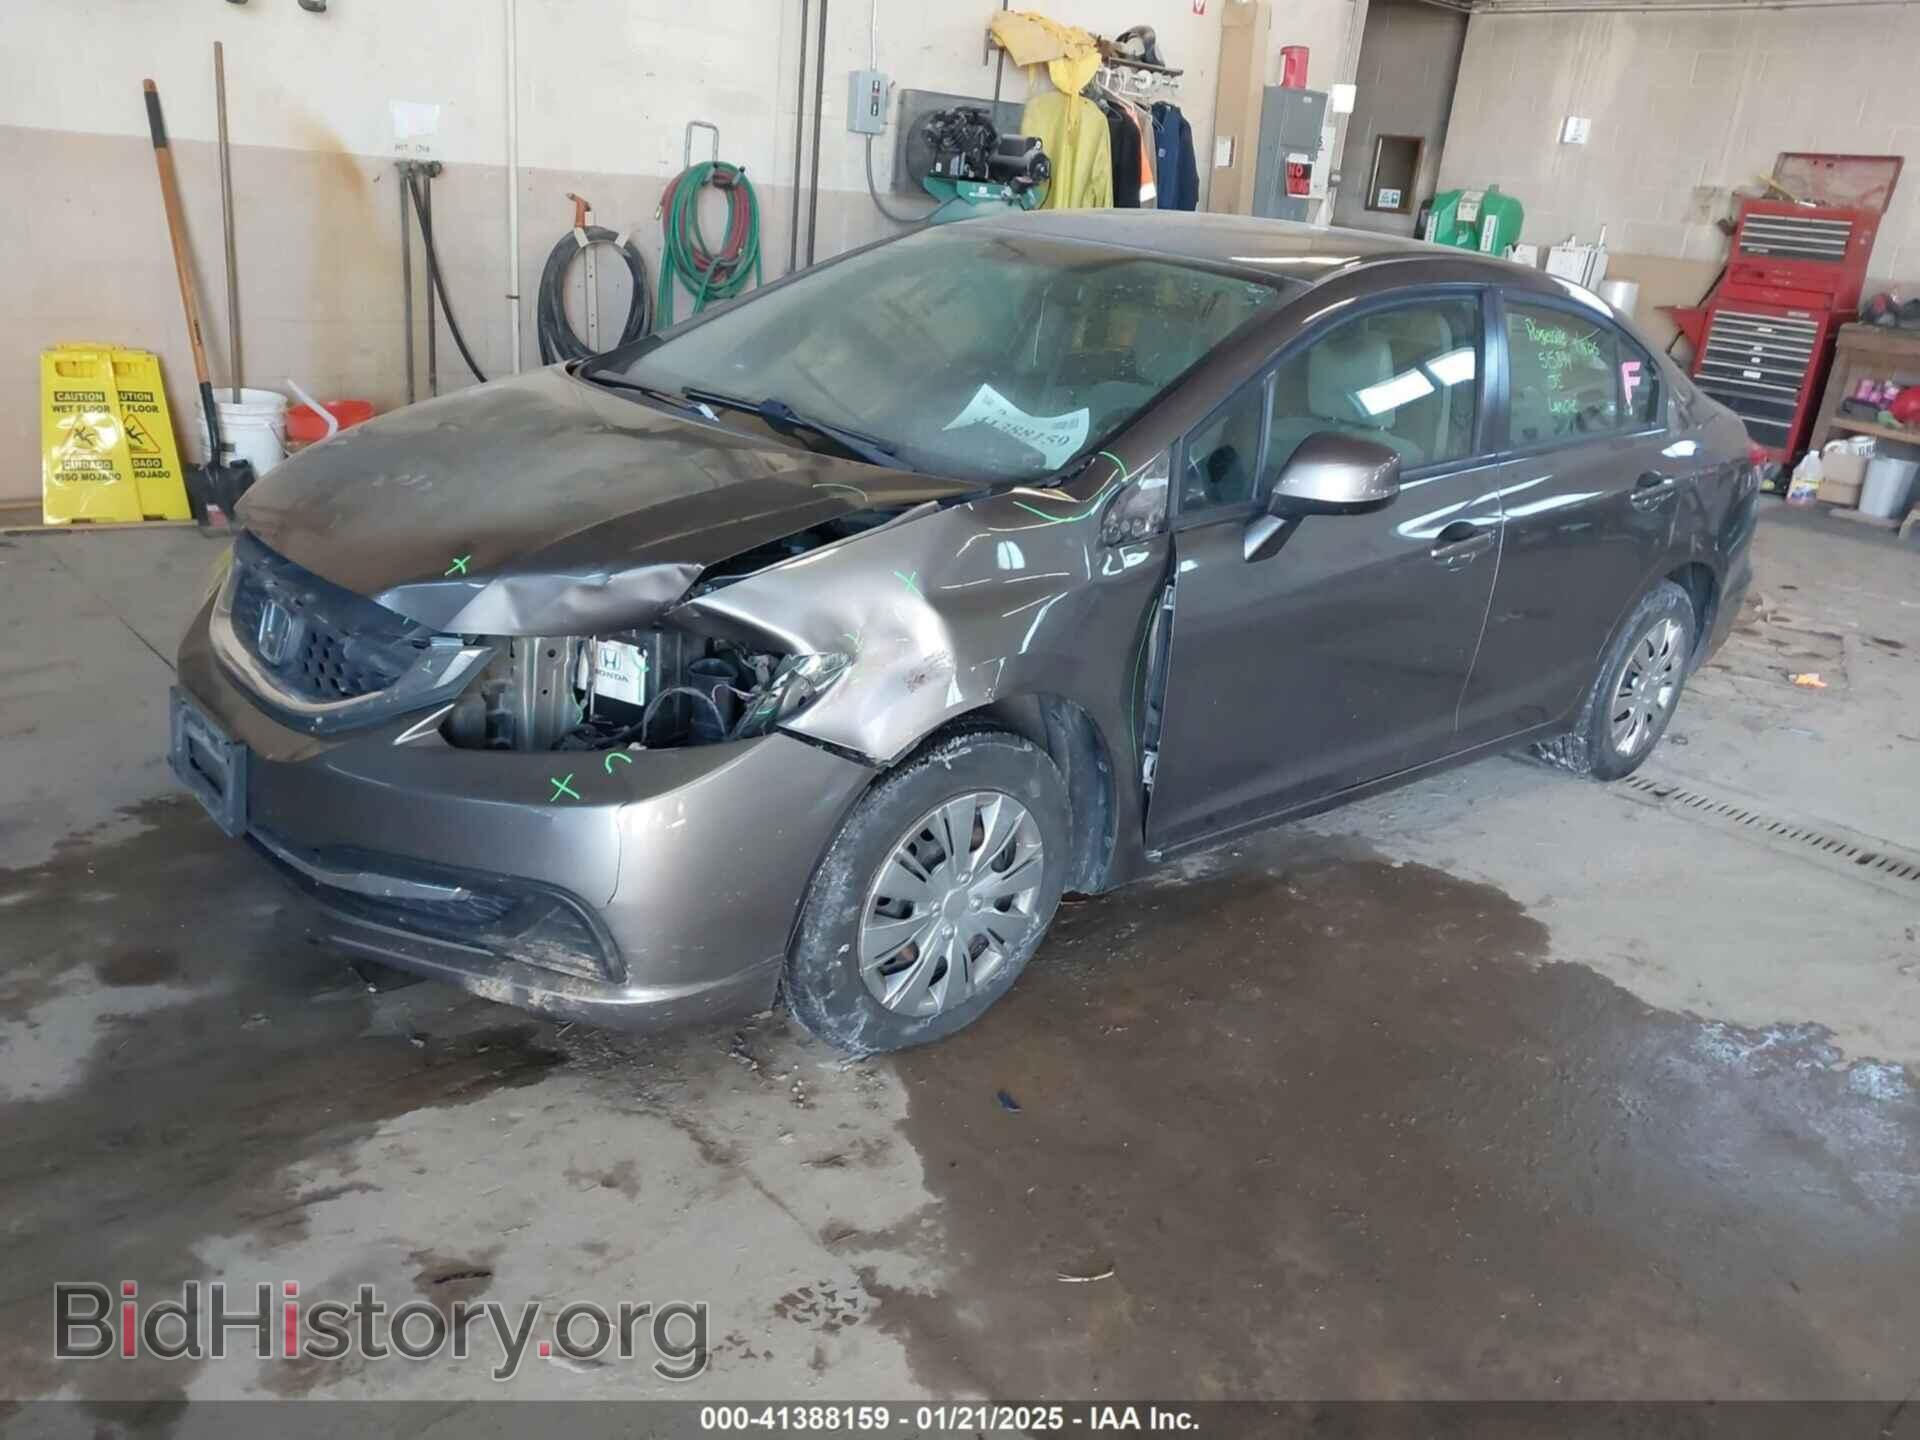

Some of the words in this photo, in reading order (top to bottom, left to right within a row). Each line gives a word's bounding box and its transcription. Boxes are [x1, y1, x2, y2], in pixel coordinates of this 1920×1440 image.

[55, 391, 104, 402] CAUTION
[119, 391, 152, 402] UTION
[53, 405, 73, 413] WET
[77, 405, 110, 413] FLOOR
[128, 405, 159, 413] FLOOR
[63, 460, 112, 470] CUIDADO
[132, 459, 160, 468] DADO
